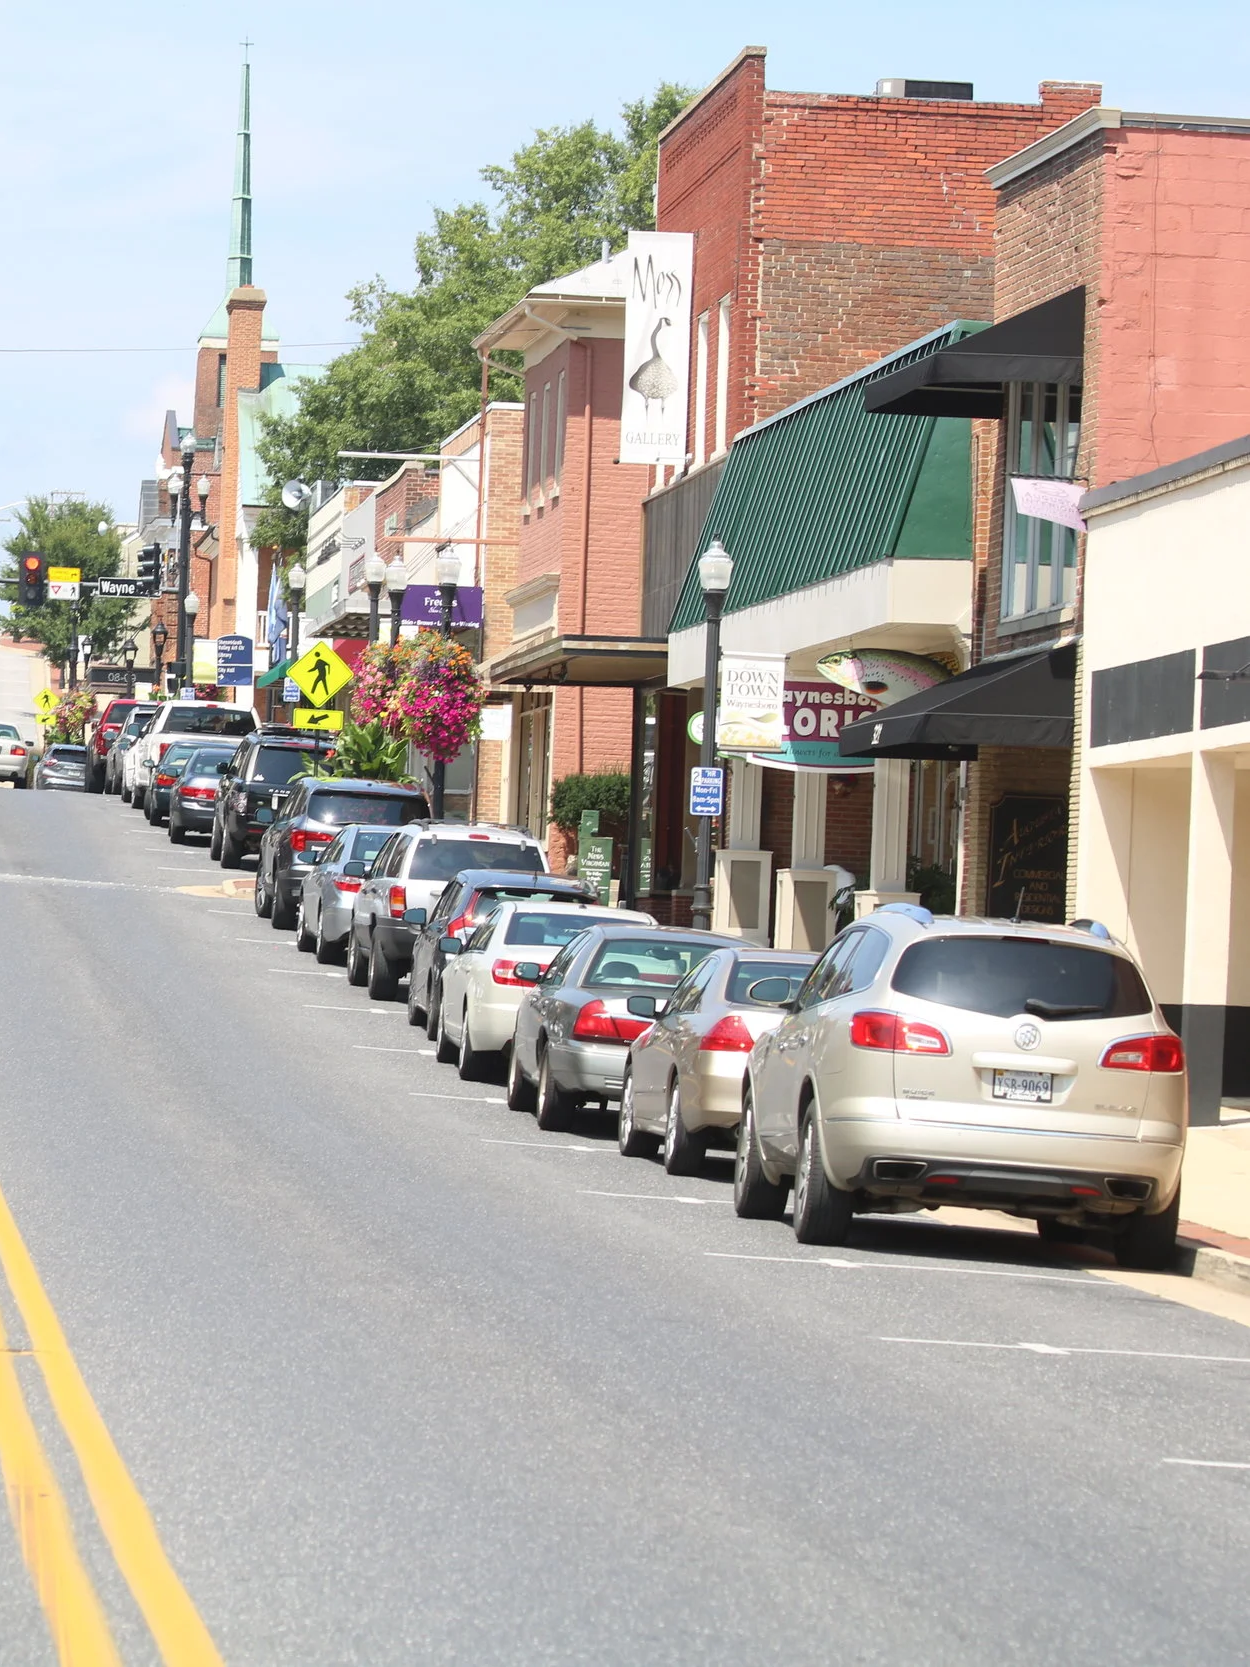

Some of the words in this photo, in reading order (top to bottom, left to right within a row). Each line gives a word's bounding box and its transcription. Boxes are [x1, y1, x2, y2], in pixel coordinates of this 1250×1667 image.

[632, 254, 682, 309] Moss
[626, 431, 680, 447] GALLERY
[101, 580, 136, 596] Wayne
[424, 597, 458, 607] Fres
[727, 670, 780, 685] DOWN
[726, 683, 779, 698] TOWN
[783, 687, 877, 706] aynesbo
[726, 698, 778, 711] Waynesboro
[693, 771, 700, 783] 2
[695, 786, 718, 794] Mon-Fri
